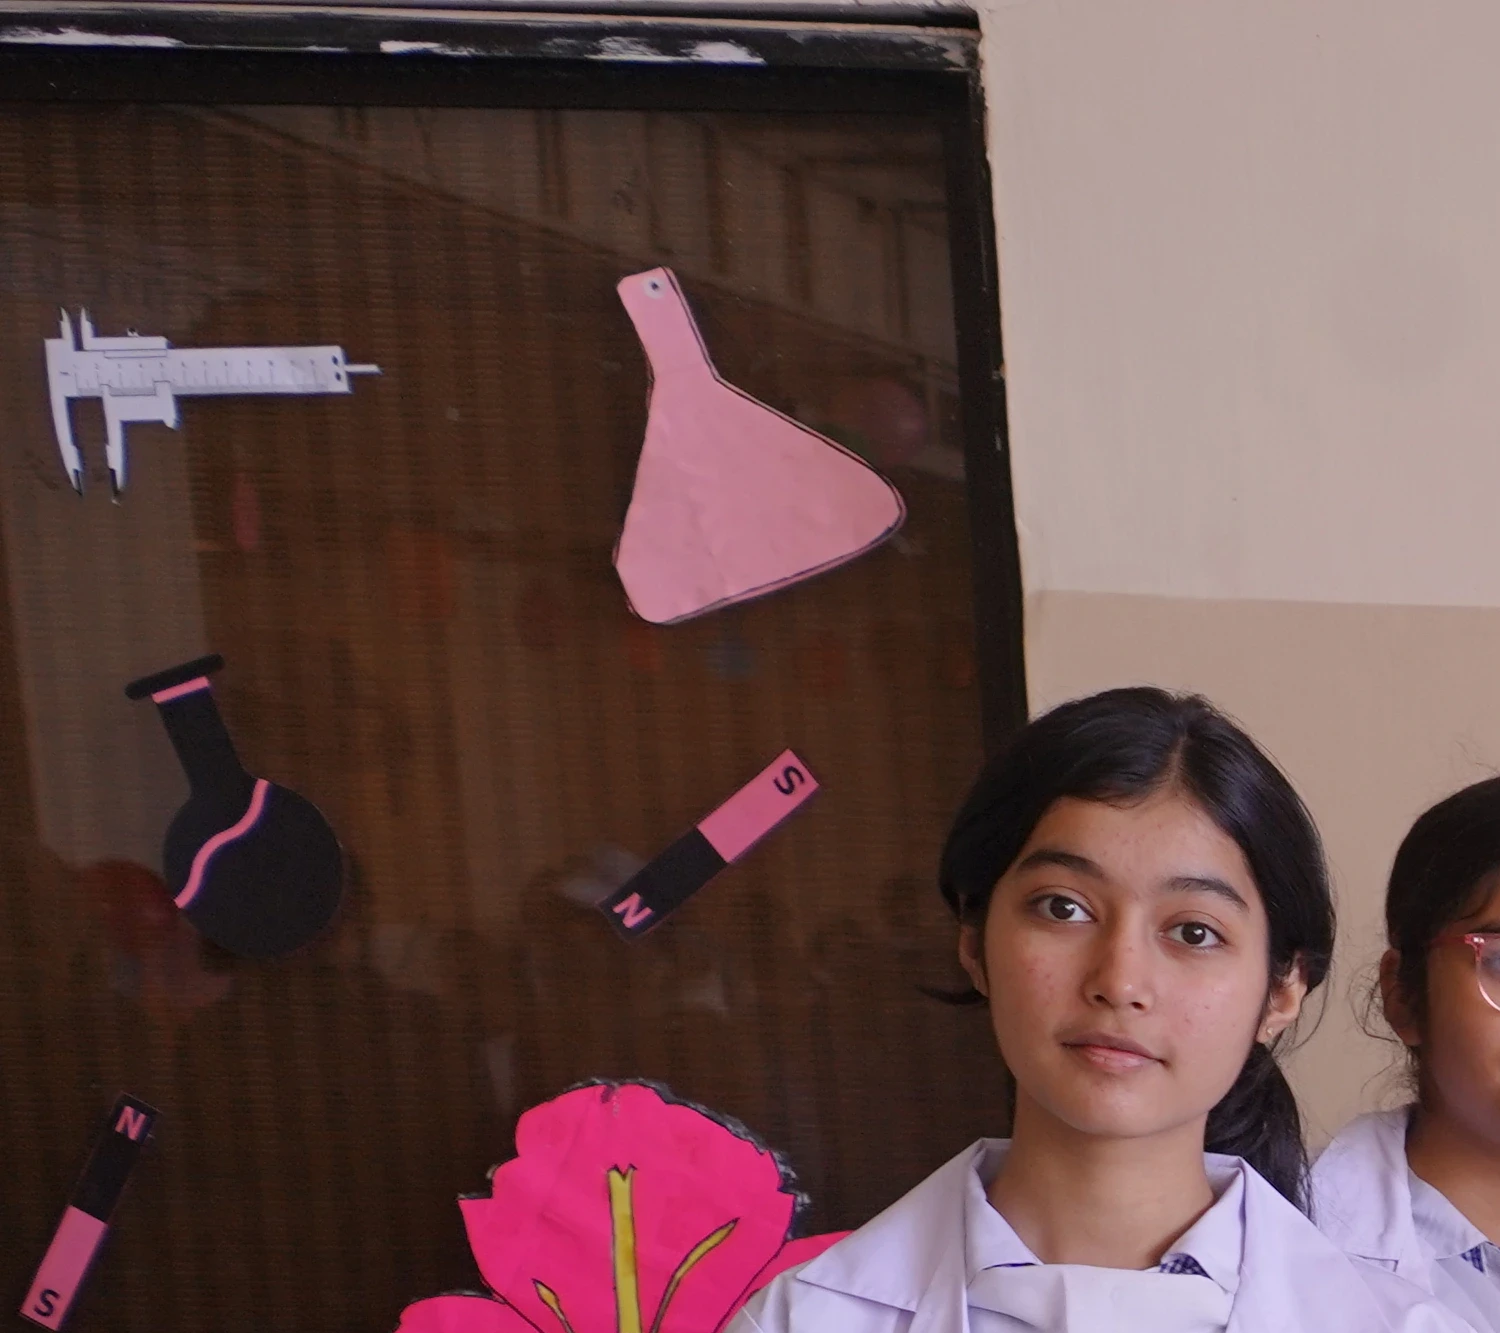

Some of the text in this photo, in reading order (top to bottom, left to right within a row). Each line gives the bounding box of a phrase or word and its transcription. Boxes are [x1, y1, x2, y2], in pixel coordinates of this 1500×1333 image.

[773, 766, 805, 796] S
[612, 892, 653, 929] N
[115, 1105, 149, 1141] N
[33, 1289, 61, 1318] S
